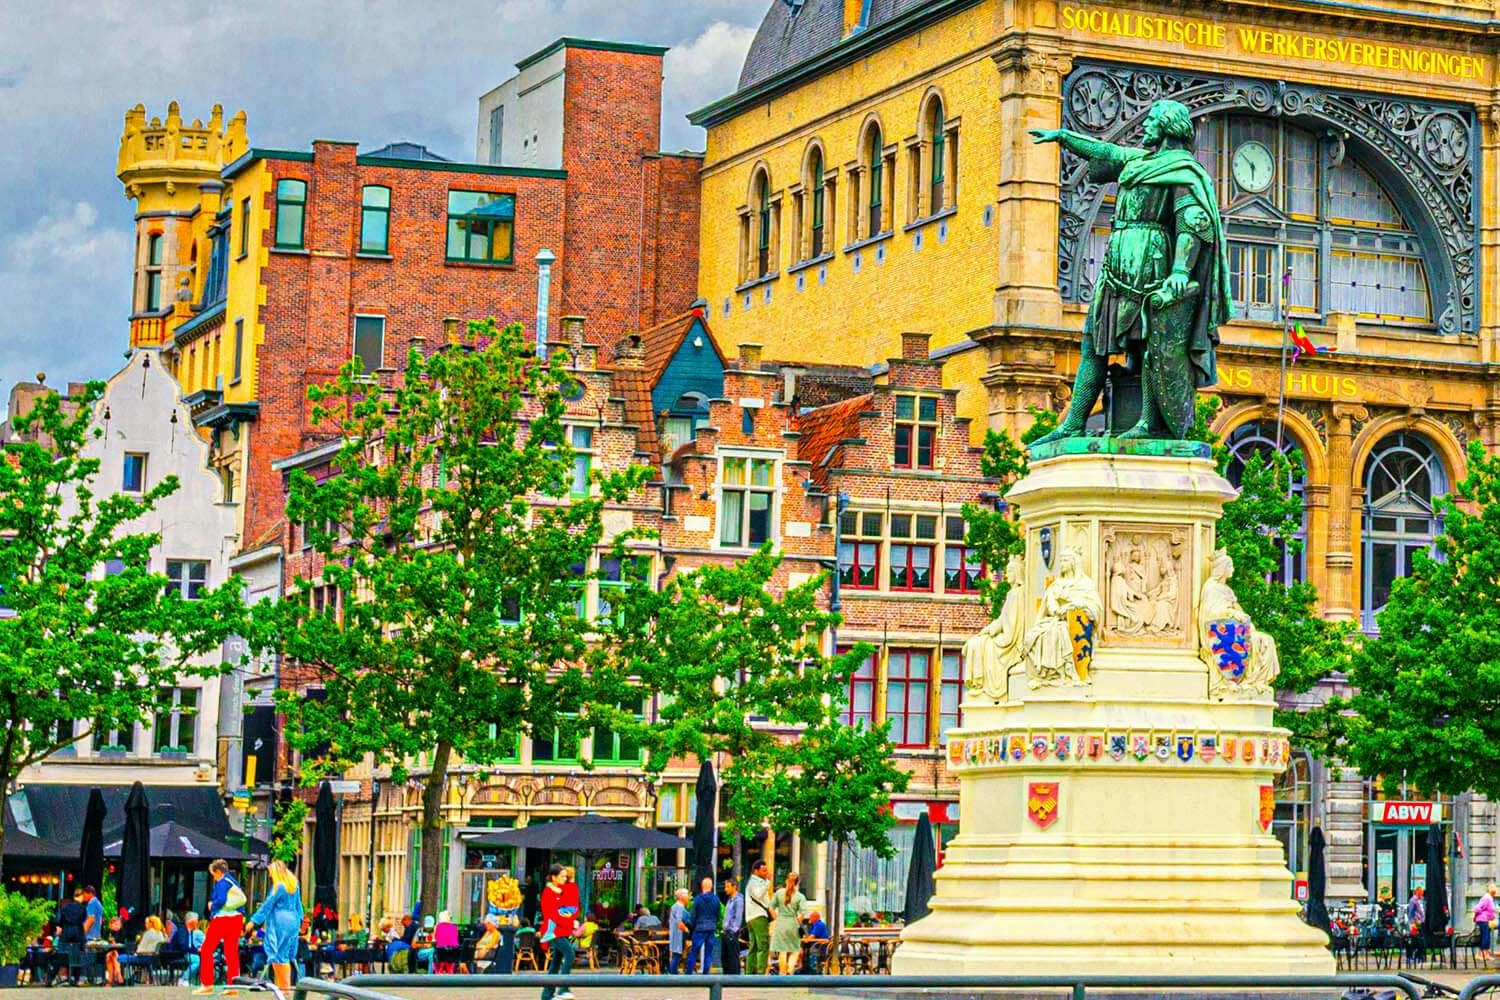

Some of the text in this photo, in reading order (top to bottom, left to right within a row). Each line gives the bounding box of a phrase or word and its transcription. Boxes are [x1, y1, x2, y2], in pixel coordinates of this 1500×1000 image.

[1062, 6, 1486, 79] SOCIALISTISCHE WERKERSVEREENIGINGEN
[1216, 366, 1359, 396] NS HUIS
[1387, 804, 1431, 820] ABVV
